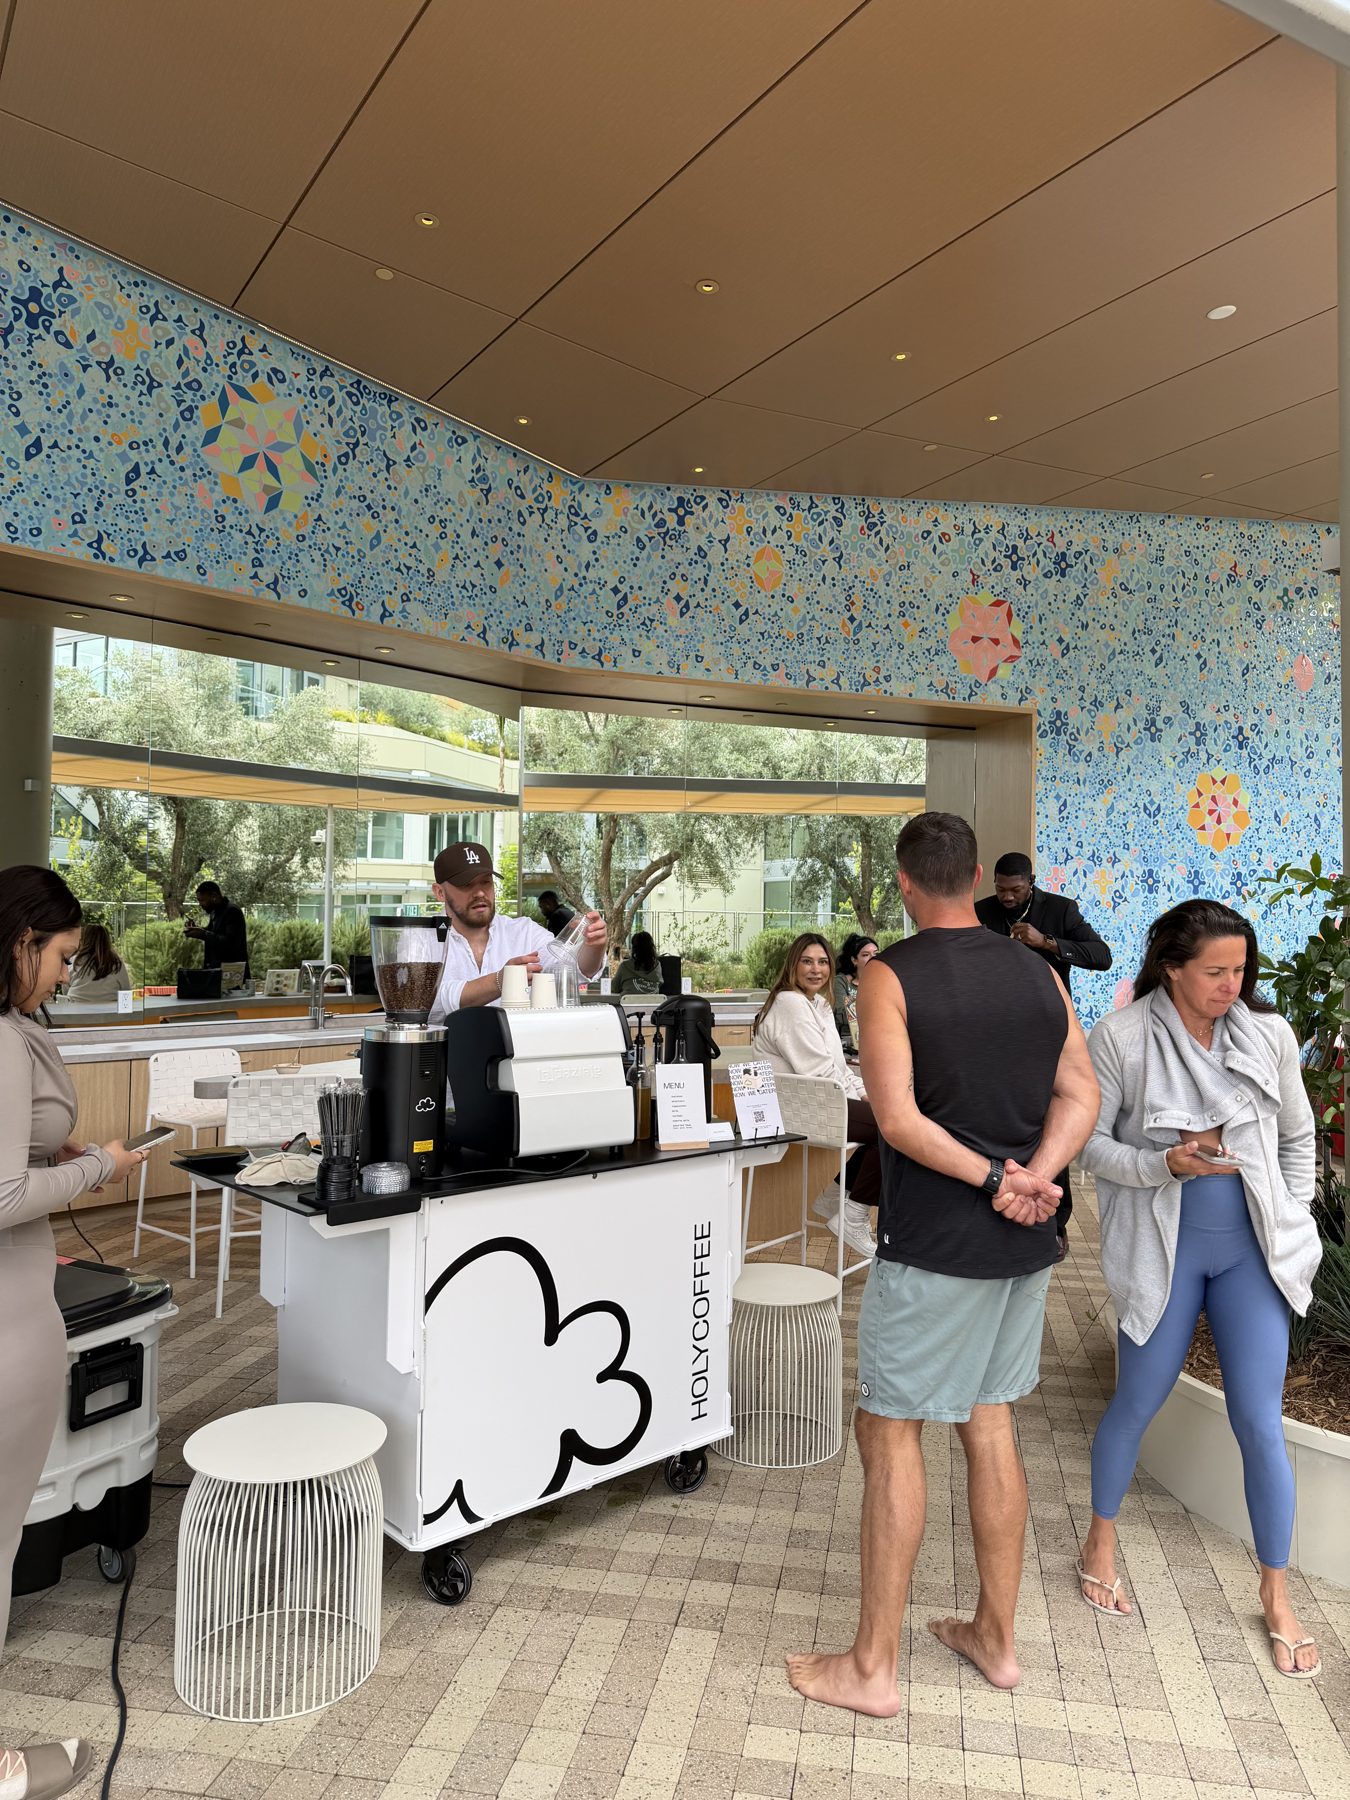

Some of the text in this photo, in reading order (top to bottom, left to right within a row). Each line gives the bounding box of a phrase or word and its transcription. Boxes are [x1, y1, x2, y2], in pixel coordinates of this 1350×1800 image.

[463, 847, 480, 864] LA
[663, 1082, 685, 1090] MENU
[691, 1221, 711, 1421] HOLYCOFFEE
